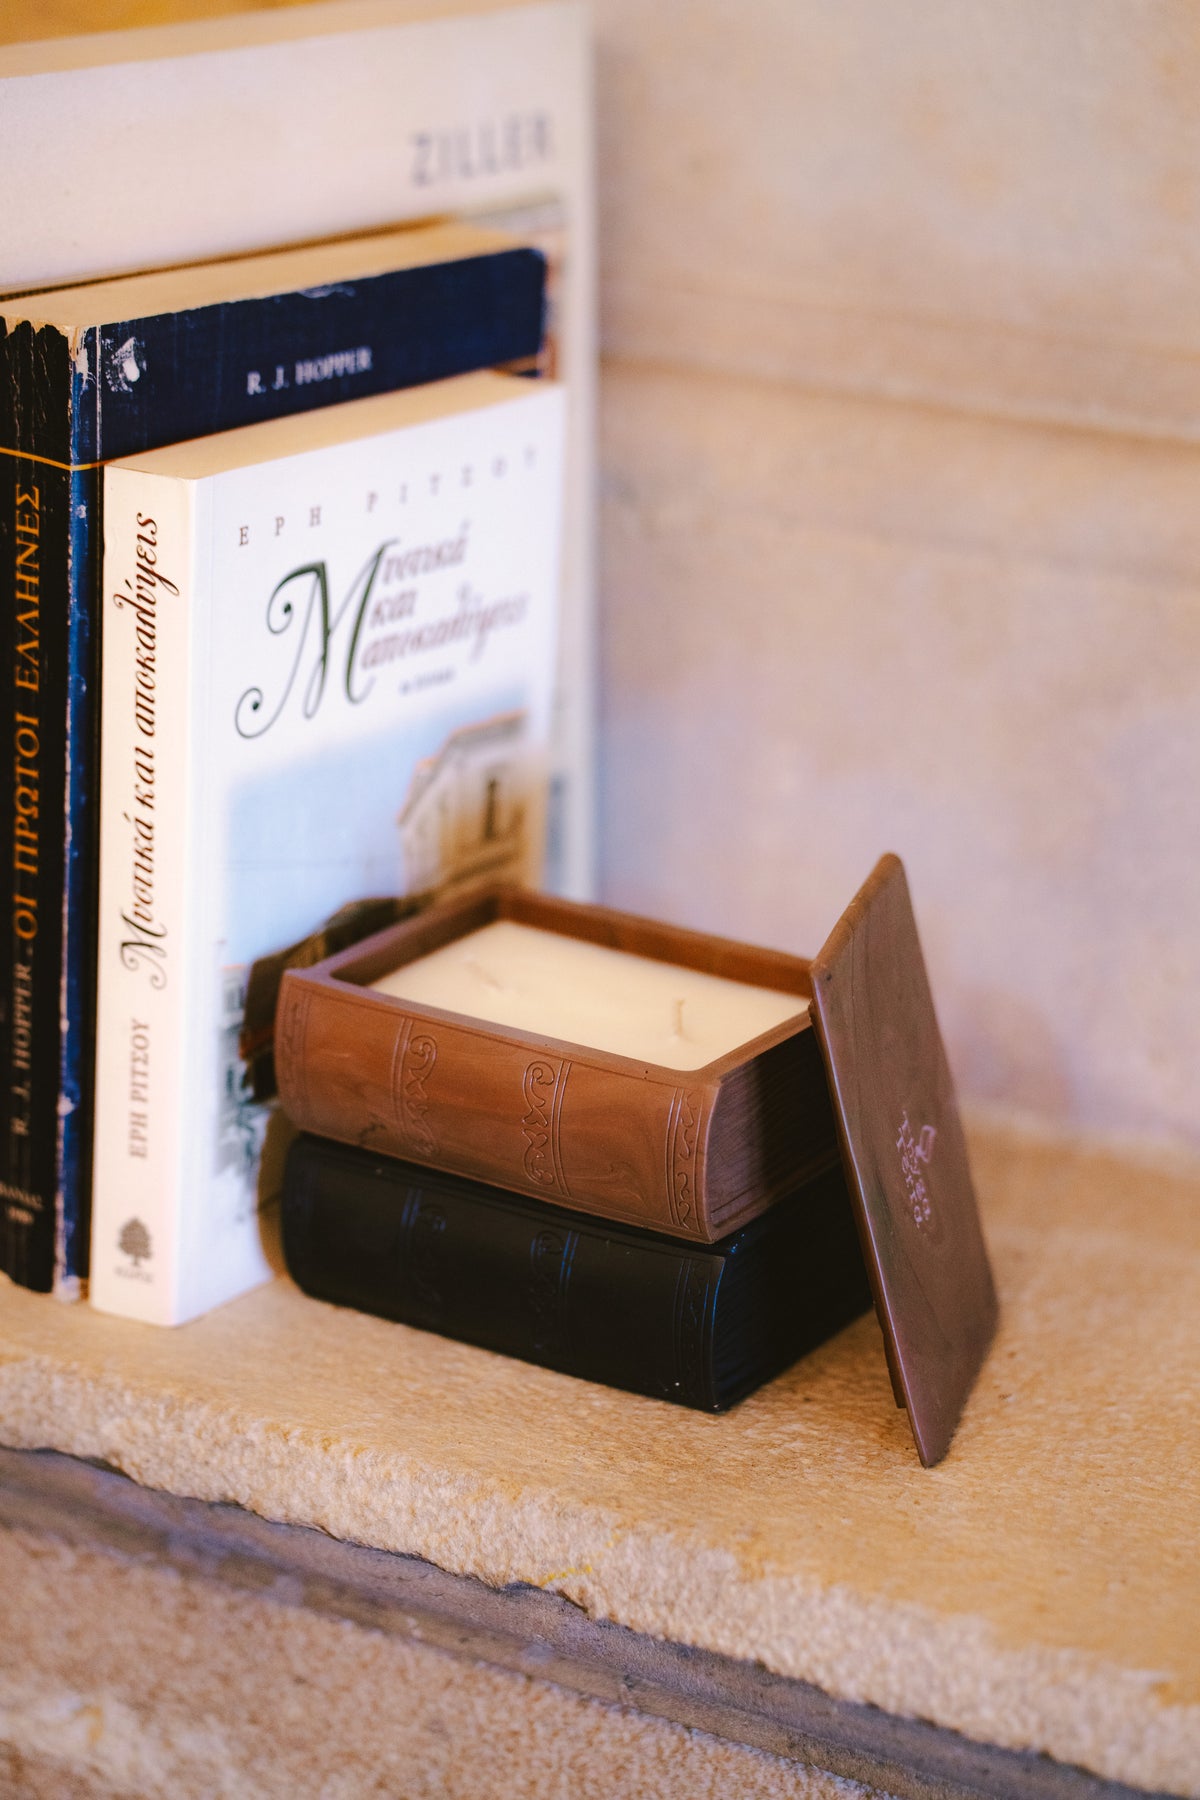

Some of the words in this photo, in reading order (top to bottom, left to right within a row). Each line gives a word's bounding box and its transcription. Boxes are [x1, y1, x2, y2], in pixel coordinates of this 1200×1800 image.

[247, 371, 267, 395] R.
[272, 365, 289, 391] J.
[295, 346, 373, 386] HOPPER
[238, 505, 322, 547] ΕΡΗ
[15, 484, 40, 693] ΕΛΛΗΝΕΣ
[13, 711, 40, 876] ΠΡΩΤΟΙ
[132, 746, 156, 814] και
[12, 894, 39, 940] ΟΙ
[130, 1017, 151, 1104] ΡΙΤΣΟΥ
[128, 1110, 149, 1159] ΕΡΗ
